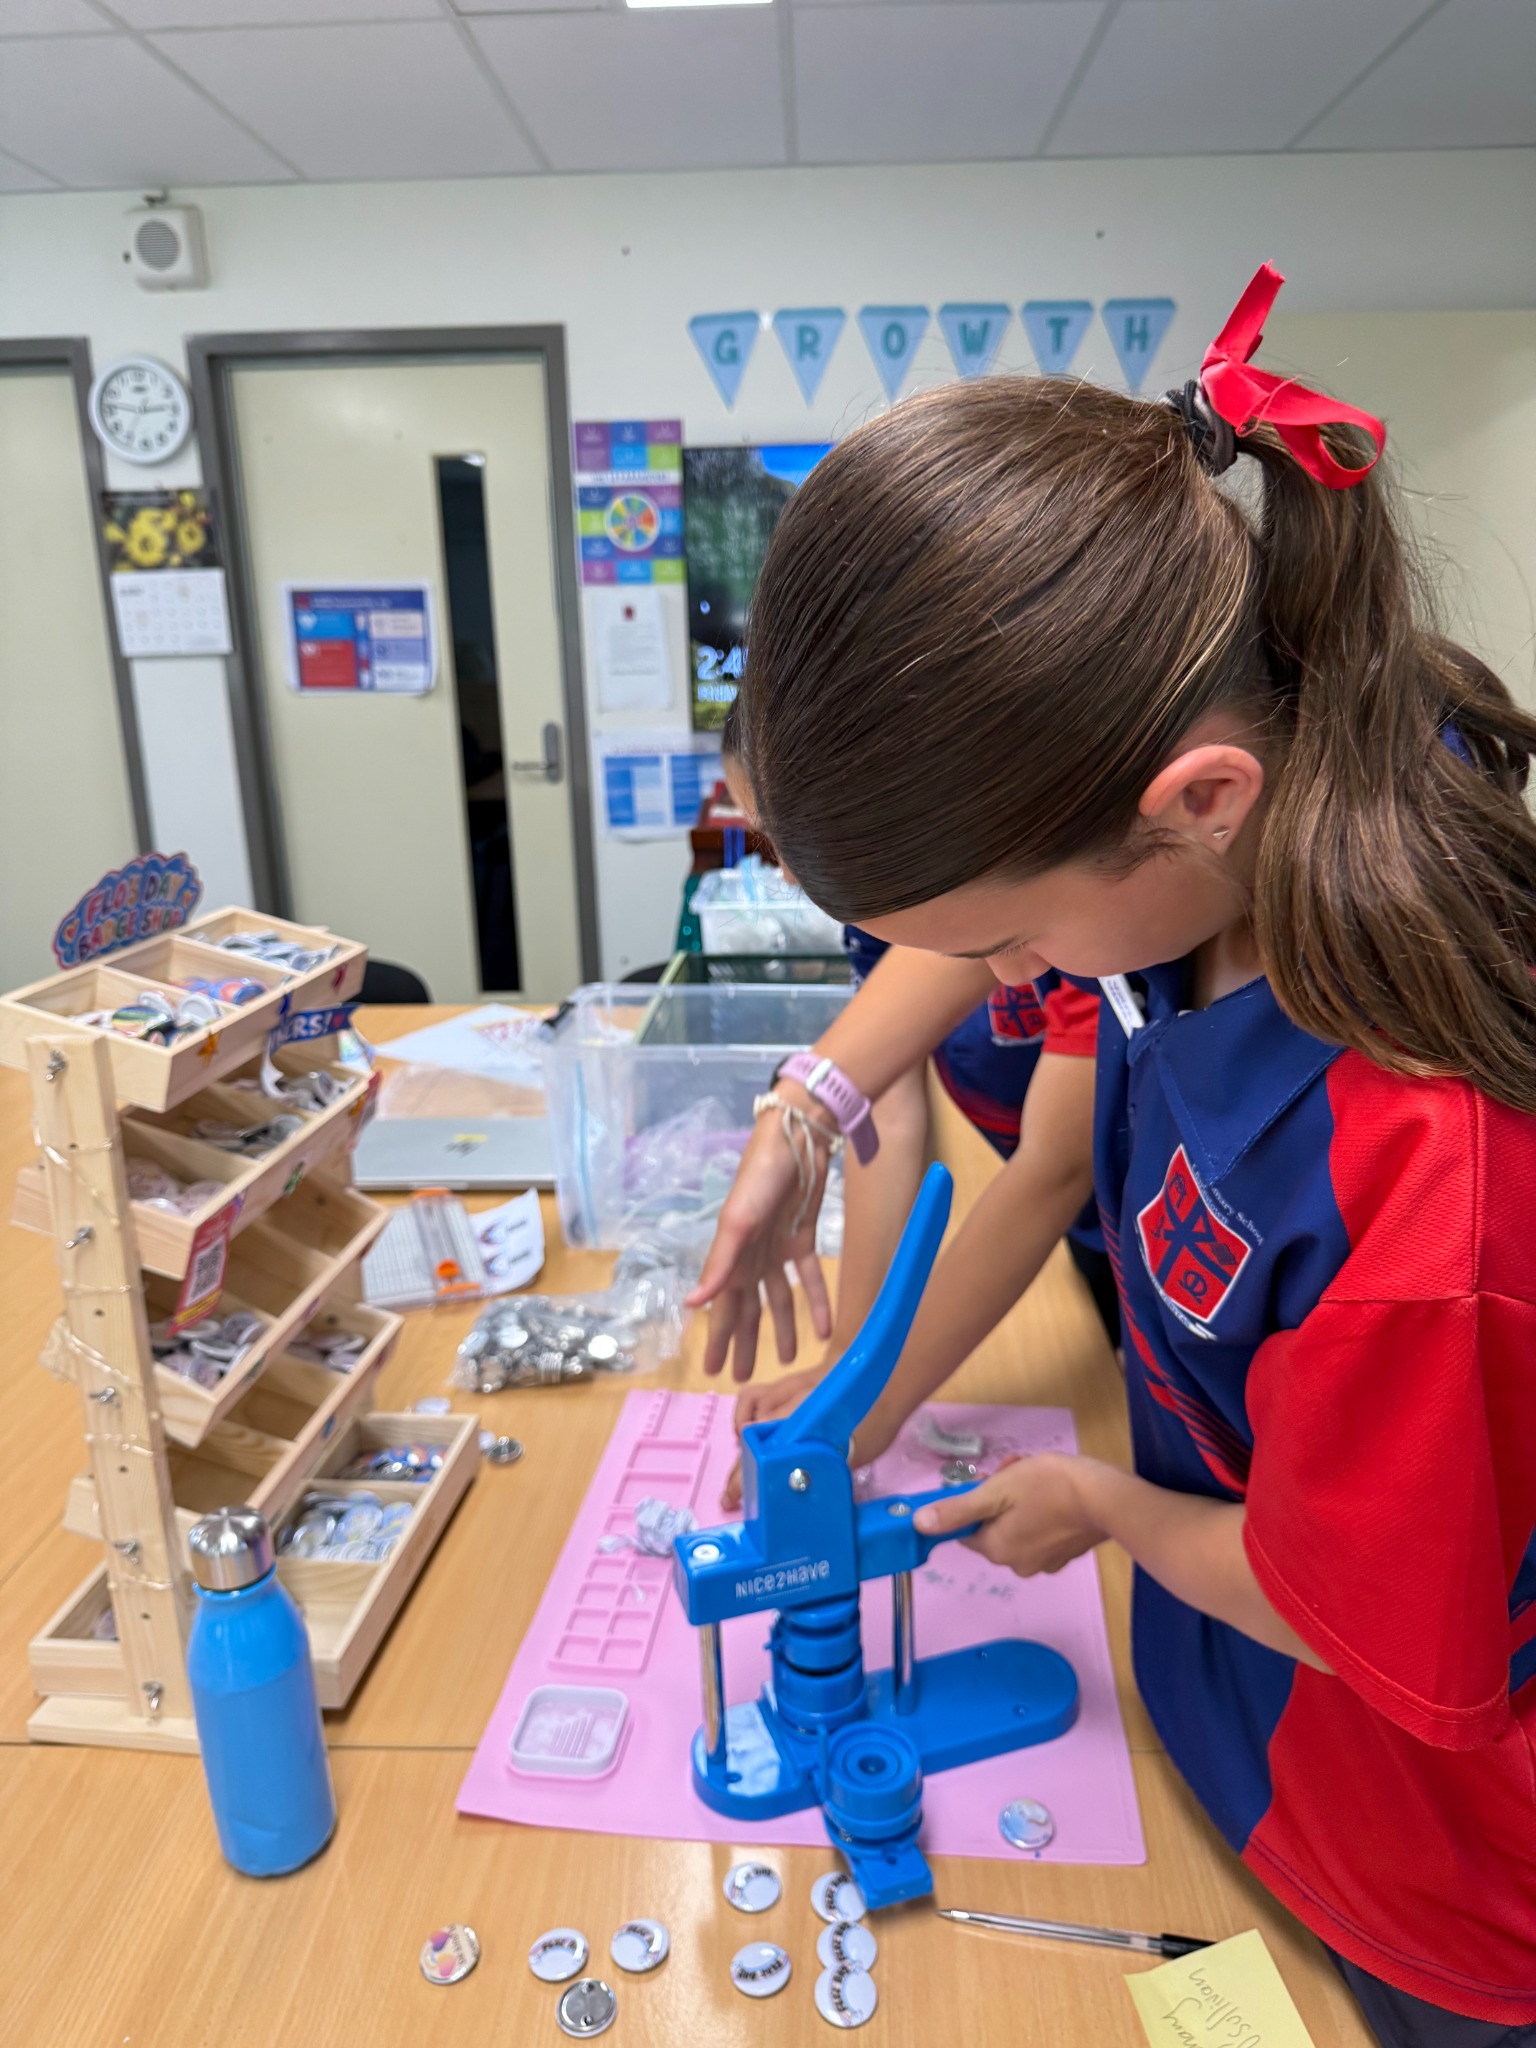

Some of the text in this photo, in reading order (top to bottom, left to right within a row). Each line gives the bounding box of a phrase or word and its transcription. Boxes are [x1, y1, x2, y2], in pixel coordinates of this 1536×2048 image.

[712, 315, 1151, 366] GROWTH
[697, 645, 749, 680] 2:4
[146, 873, 187, 902] DAY
